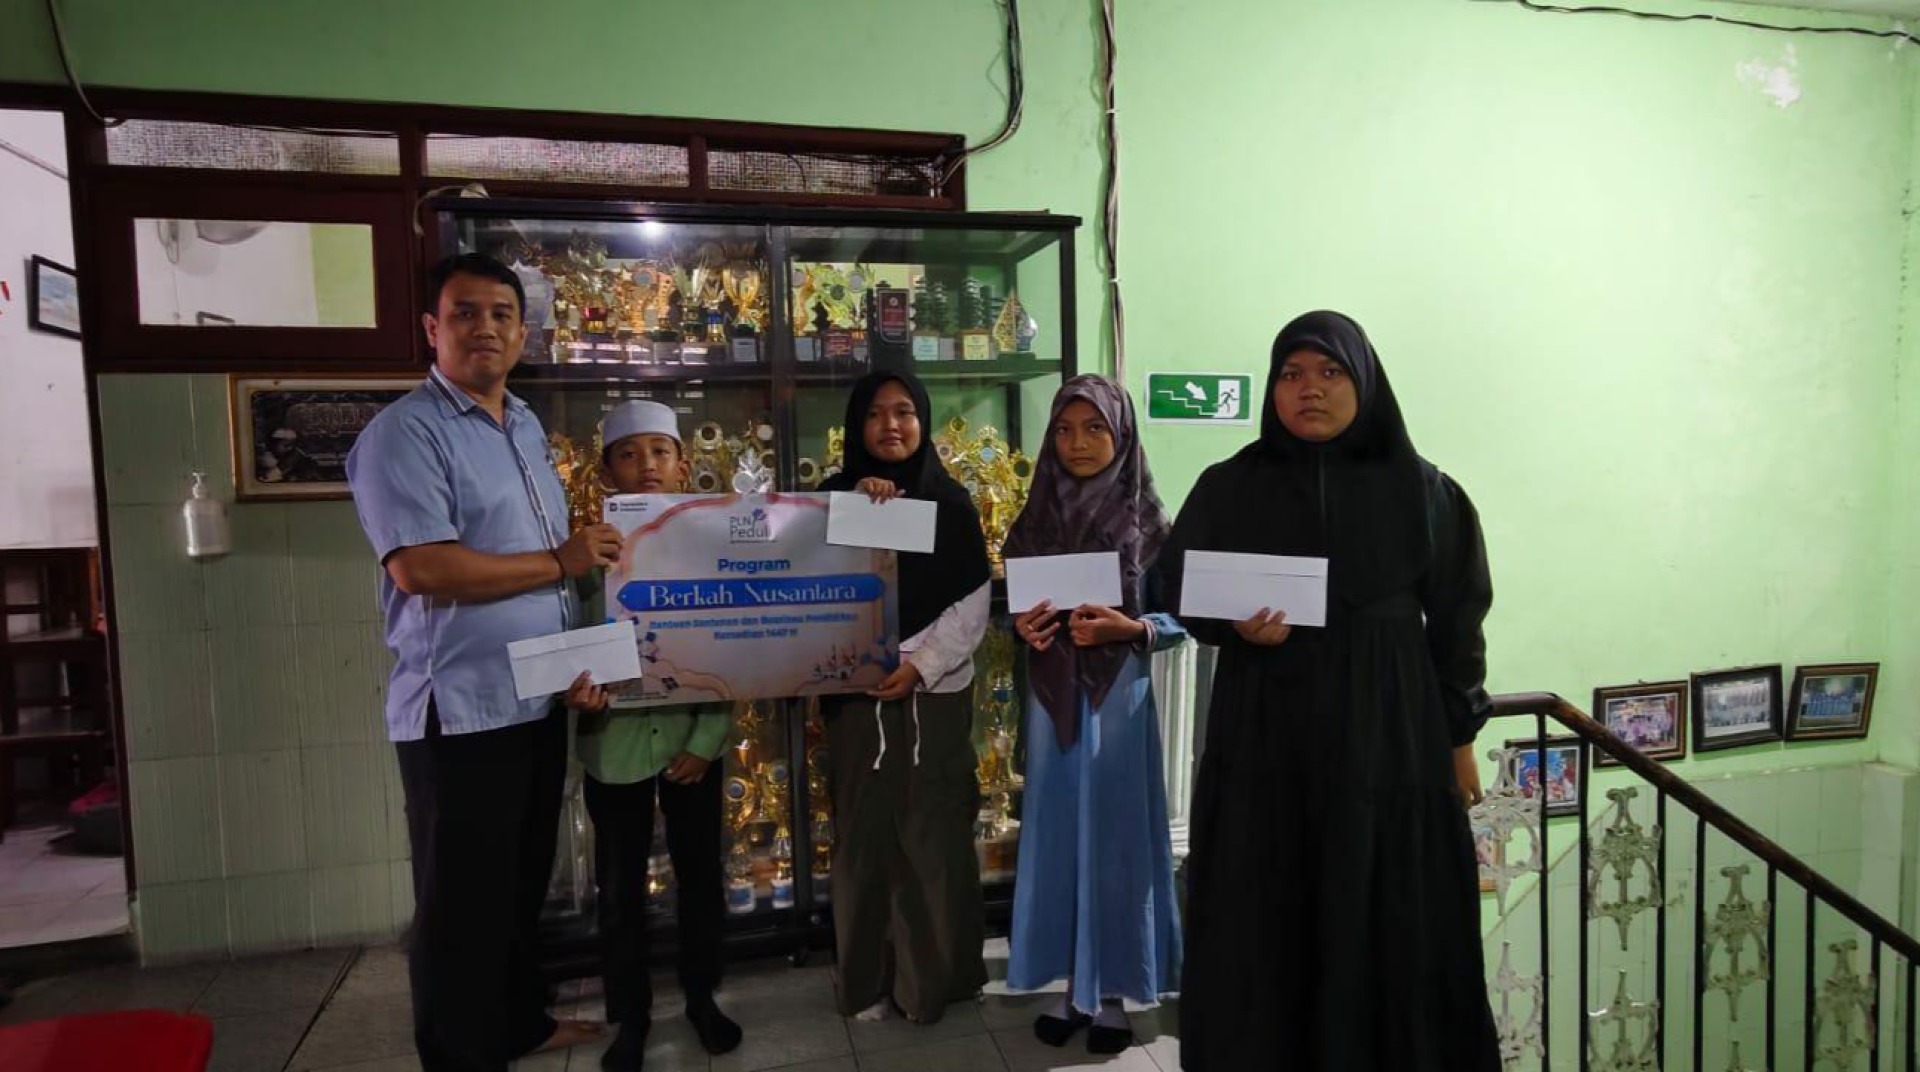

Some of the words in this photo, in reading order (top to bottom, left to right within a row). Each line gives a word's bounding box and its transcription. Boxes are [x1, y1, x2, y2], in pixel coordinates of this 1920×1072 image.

[718, 558, 791, 574] Program
[650, 583, 734, 608] Berkah
[744, 582, 857, 604] Nusantara
